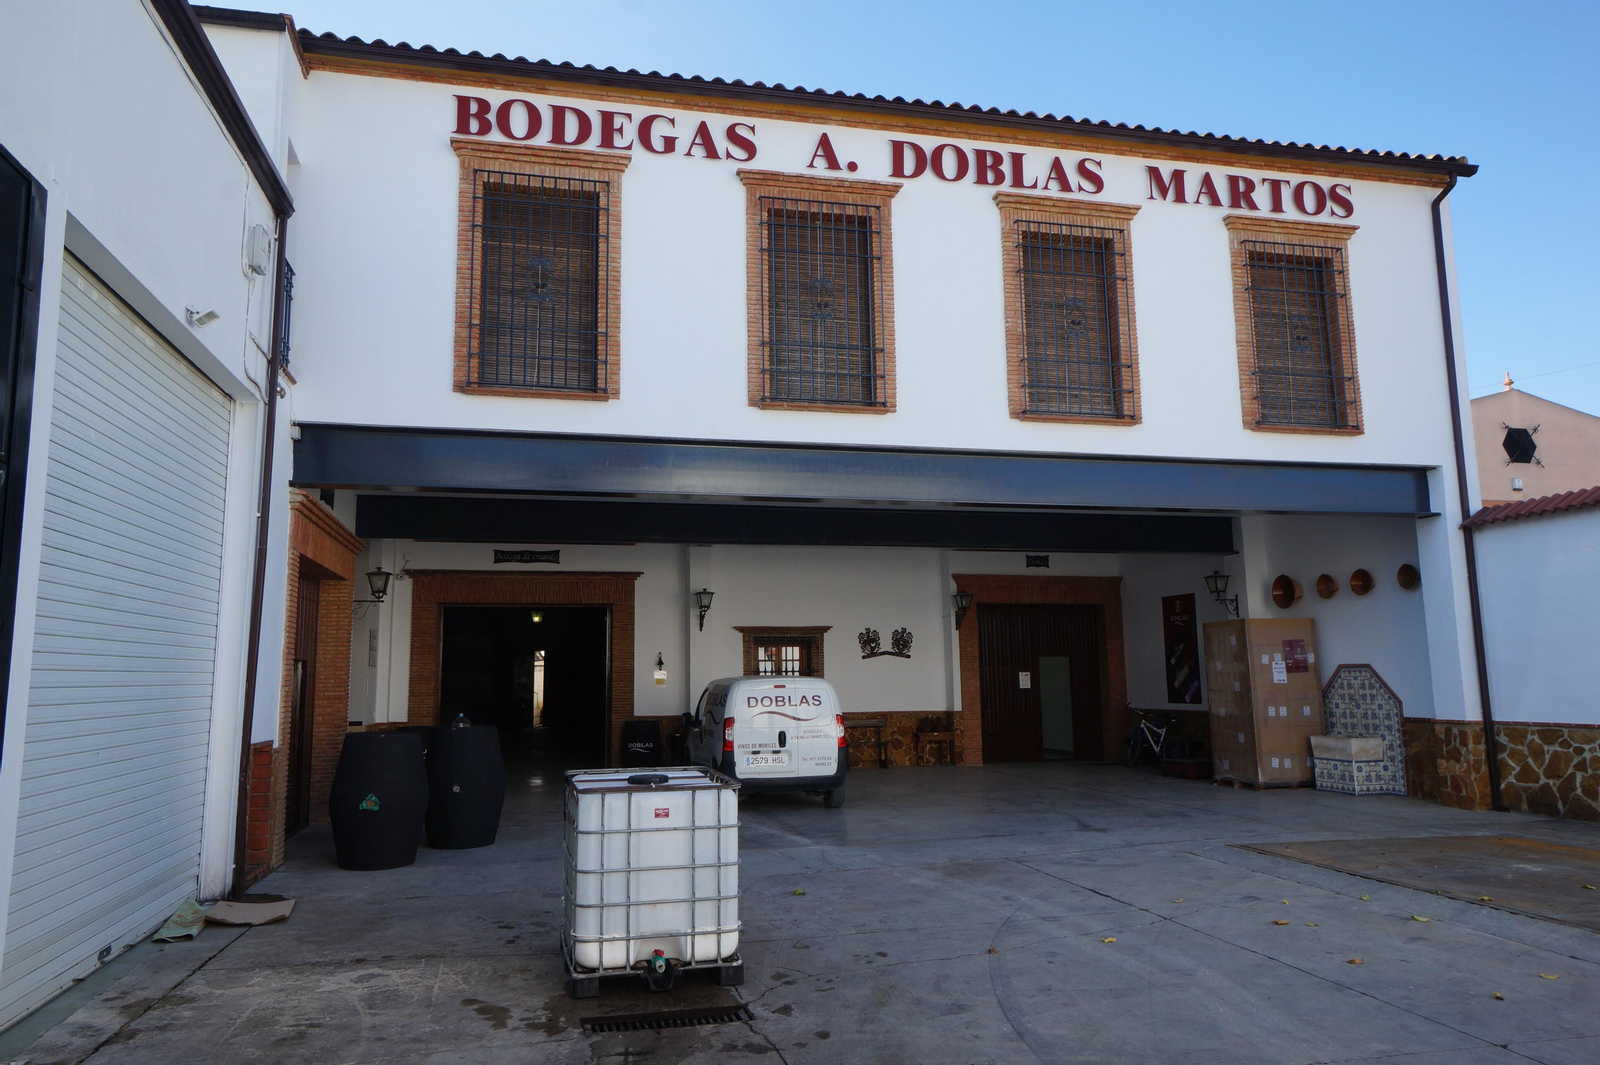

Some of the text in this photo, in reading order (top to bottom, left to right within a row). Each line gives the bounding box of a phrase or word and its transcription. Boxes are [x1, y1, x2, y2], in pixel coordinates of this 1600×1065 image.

[451, 94, 1355, 219] BODEGAS A. DOBLAS MARTOS
[523, 552, 531, 560] de
[747, 695, 822, 708] DOBLAS
[750, 756, 785, 765] 2579 HSL
